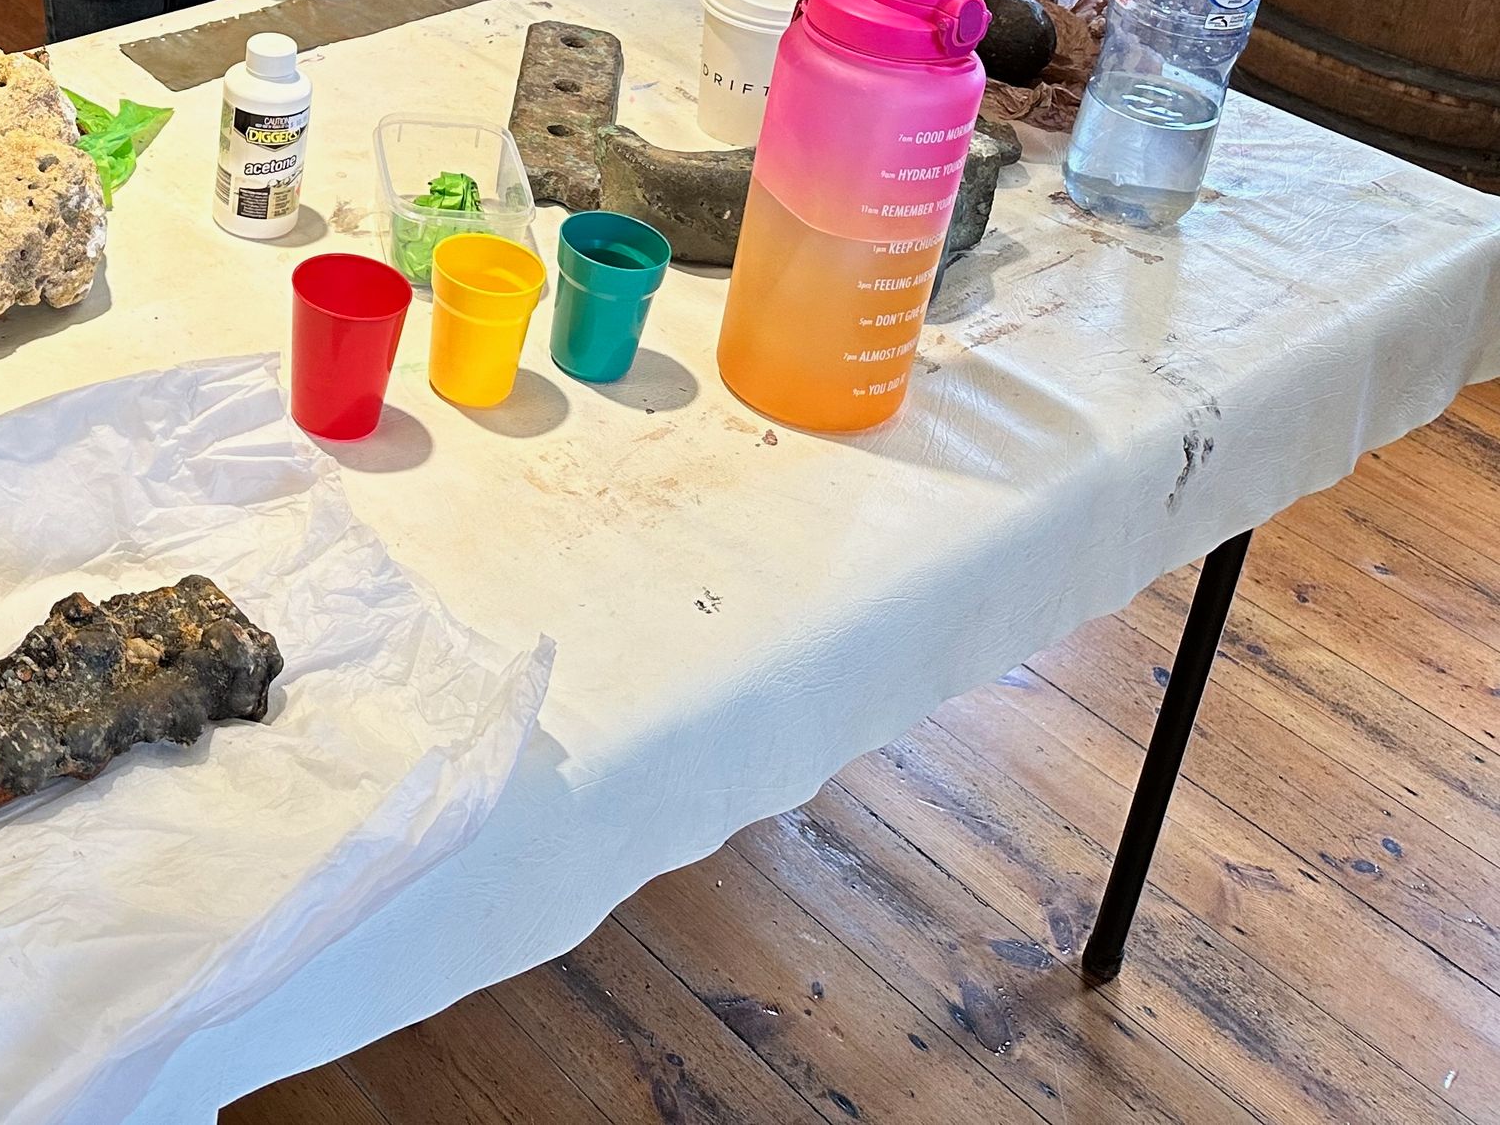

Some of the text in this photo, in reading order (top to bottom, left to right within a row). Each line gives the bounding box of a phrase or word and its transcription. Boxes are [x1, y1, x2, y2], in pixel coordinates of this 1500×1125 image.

[915, 130, 945, 145] GOOD
[244, 154, 297, 176] acetone
[898, 166, 942, 181] HYDRATE
[881, 201, 935, 217] REMEMBER
[888, 241, 914, 255] KEEP
[874, 276, 912, 291] FEELING
[875, 311, 905, 327] DON'T
[859, 347, 897, 363] ALMOST
[869, 382, 887, 396] YOU
